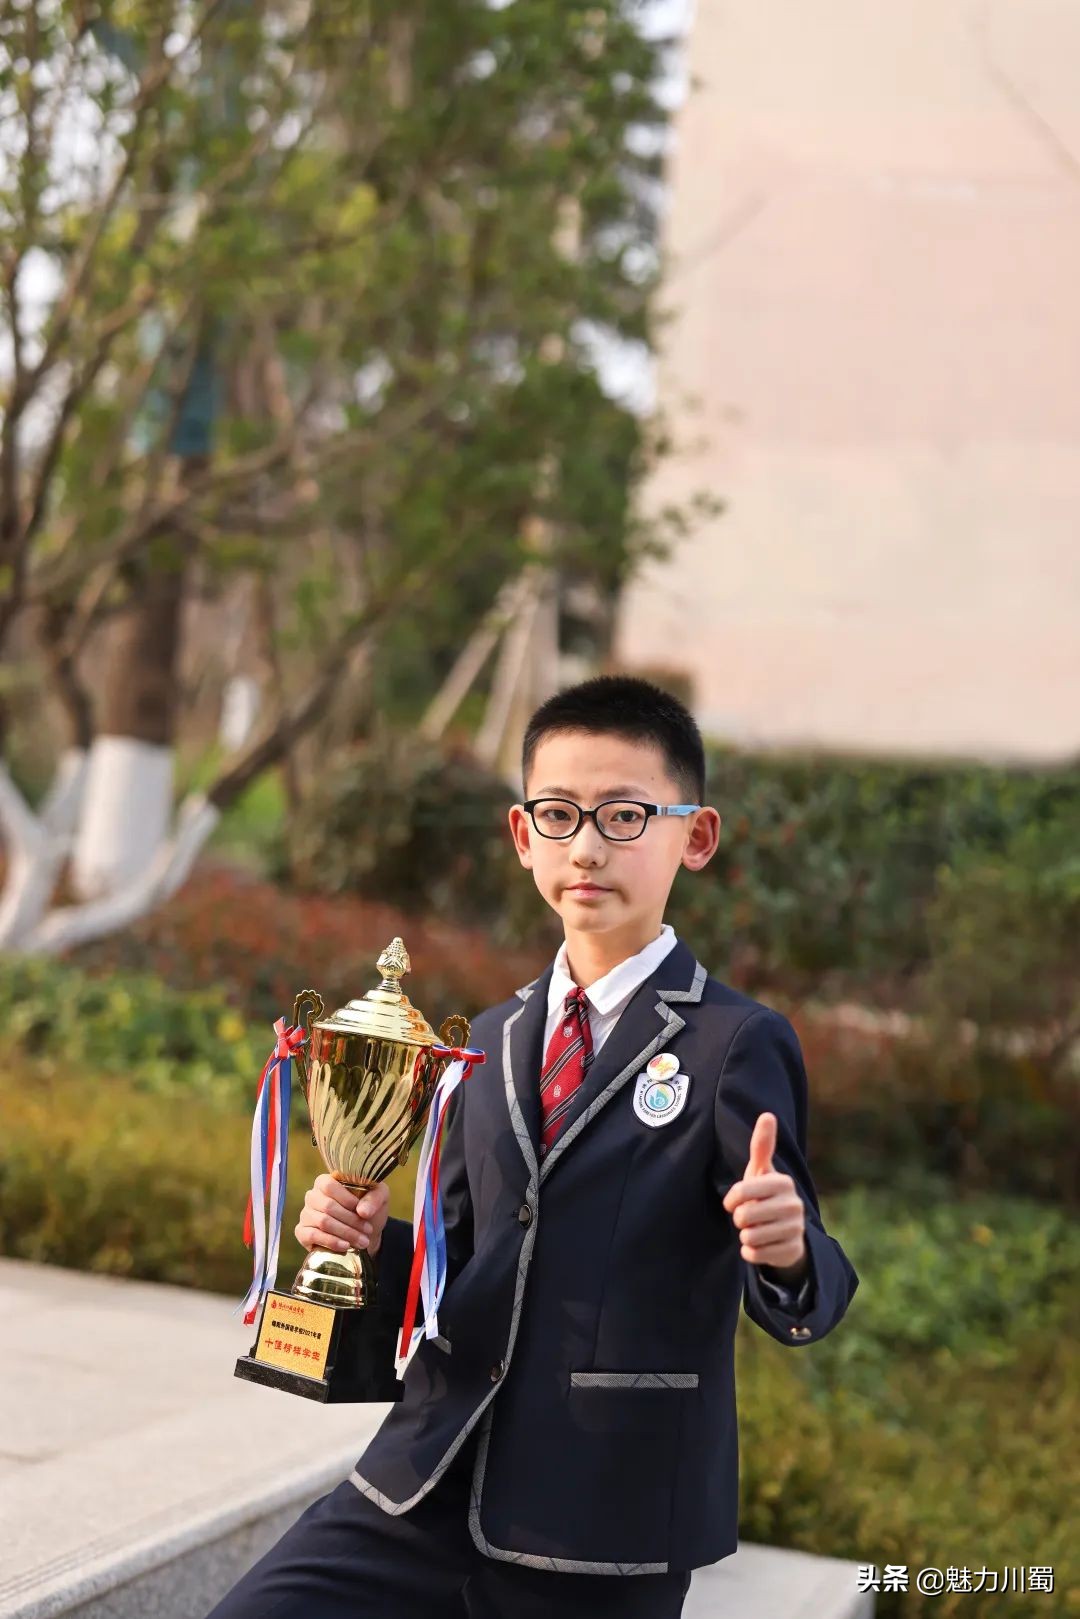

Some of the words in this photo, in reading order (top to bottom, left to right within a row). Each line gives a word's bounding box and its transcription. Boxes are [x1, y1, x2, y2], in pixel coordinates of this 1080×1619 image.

[264, 1338, 320, 1361] 十佳榜样学生
